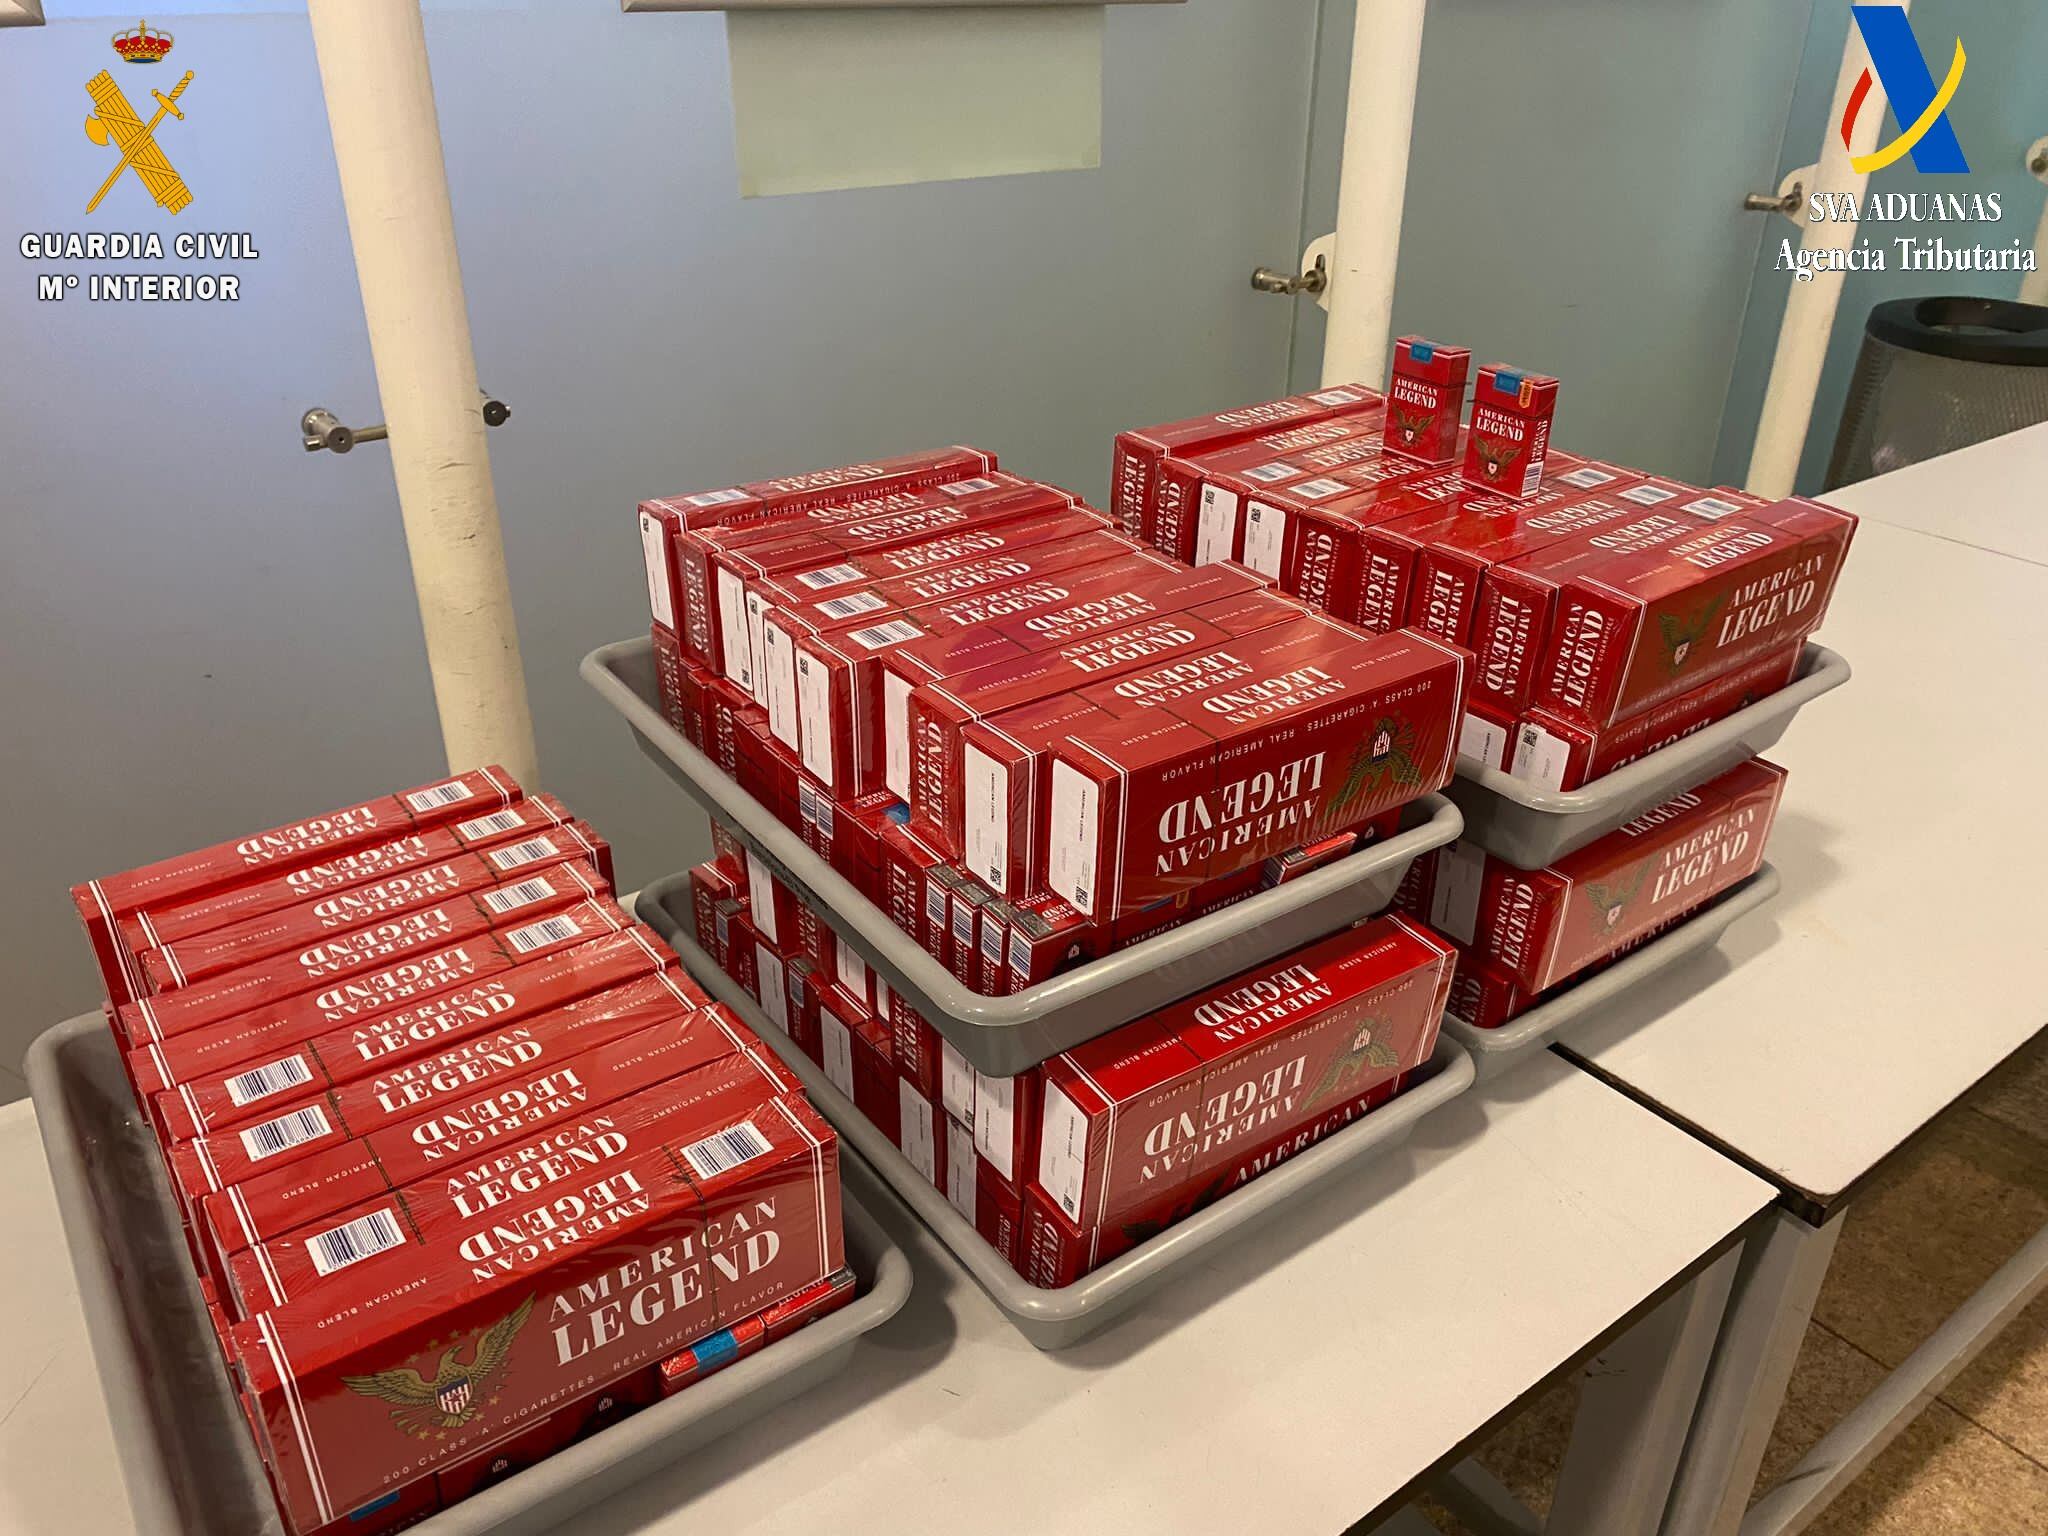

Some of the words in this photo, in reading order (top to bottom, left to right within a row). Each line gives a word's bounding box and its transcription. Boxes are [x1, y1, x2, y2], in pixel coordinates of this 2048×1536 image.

[1394, 387, 1437, 409] LEGEND
[1395, 378, 1438, 396] AMERICAN
[1265, 426, 1350, 451] LEGEND
[1476, 417, 1523, 441] LEGEND
[1478, 408, 1525, 428] AMERICAN
[775, 467, 884, 492] LEGEND
[1313, 442, 1383, 467] LEGEN
[848, 506, 962, 537] LEGEND
[862, 513, 969, 541] AMERICAN
[1155, 476, 1168, 548] MERICAN
[1163, 482, 1181, 558] EGEND
[1526, 499, 1614, 530] LEGEND
[1589, 515, 1677, 549] LEGEND
[881, 530, 991, 560] AMERICAN
[890, 535, 1005, 570] LEGEND
[1668, 525, 1749, 558] AMERICAN
[1683, 532, 1773, 568] LEGEND
[904, 555, 1015, 587] AMERICAN
[911, 561, 1031, 598] LEGEND
[1310, 534, 1332, 609] EGEND
[1363, 555, 1388, 634] LEGEN
[1729, 554, 1824, 610] AMERICAN
[939, 580, 1053, 615] AMERICAN
[950, 587, 1069, 626] LEGEND
[1025, 591, 1147, 631] LEGEND
[1042, 603, 1157, 640] AMERICAN
[1381, 561, 1399, 636] AMERIC
[1427, 570, 1453, 639] LEGE
[1446, 577, 1465, 640] AMERI
[1716, 580, 1815, 648] LEGEND
[1059, 621, 1177, 659] AMERICAN
[1070, 629, 1196, 673] LEGEND
[1486, 595, 1519, 691] LEGEND
[1504, 602, 1532, 698] AMERICAN
[1551, 602, 1583, 698] AMERICAN
[1564, 610, 1603, 707] LEGEND
[1114, 651, 1241, 698] LEGEND
[1135, 663, 1254, 709] AMERICAN
[1202, 665, 1333, 714] LEGEND
[1386, 688, 1413, 705] CLASS
[1225, 678, 1346, 725] AMERICAN
[1307, 704, 1365, 732] CIGARETTES
[1210, 739, 1264, 767] AMERICAN
[1269, 729, 1295, 744] REAL
[927, 721, 943, 827] LEGEND
[1159, 752, 1327, 844] LEGEND
[1162, 762, 1206, 782] FLAVOR
[236, 806, 376, 857] LEGEND
[1155, 795, 1320, 876] AMERICAN
[1619, 793, 1702, 837] LEGEND
[1659, 808, 1754, 868] AMERICAN
[244, 818, 378, 866] AMERICAN
[286, 835, 425, 886] LEGEND
[1651, 831, 1749, 905] LEGEND
[294, 847, 428, 896] AMERICAN
[313, 865, 458, 918] LEGEND
[322, 877, 461, 929] AMERICAN
[1491, 877, 1514, 954] AMERICAN
[1501, 884, 1534, 969] LEGEND
[299, 908, 450, 968] LEGEND
[307, 922, 453, 978] AMERICAN
[316, 947, 471, 1010] LEGEND
[325, 962, 476, 1023] AMERICAN
[1193, 964, 1321, 1027] LEGEND
[352, 981, 504, 1044] AMERICAN
[355, 991, 516, 1061] LEGEND
[1215, 984, 1333, 1042] AMERICAN
[1290, 1012, 1348, 1043] CIGARETTES
[372, 1026, 531, 1093] AMERICAN
[1254, 1041, 1279, 1058] REAL
[376, 1040, 543, 1114] LEGEND
[411, 1068, 582, 1145] LEGEND
[423, 1086, 588, 1162] AMERICAN
[652, 1095, 702, 1120] AMERICAN
[1144, 1055, 1307, 1157] LEGEND
[446, 1115, 615, 1195] AMERICAN
[1139, 1093, 1303, 1185] AMERICAN
[1234, 1096, 1371, 1186] AMERICAN
[282, 1182, 320, 1200] BLEND
[451, 1131, 628, 1220] LEGEND
[459, 1170, 645, 1263] LEGEND
[471, 1194, 650, 1284] AMERICAN
[549, 1197, 777, 1323] AMERICAN
[365, 1276, 428, 1309] AMERICAN
[552, 1229, 781, 1367] LEGEND
[316, 1308, 360, 1330] BLEND
[383, 1466, 410, 1484] 200
[418, 1438, 468, 1467] CLASS
[503, 1374, 595, 1426] CIGARETTES
[613, 1349, 648, 1370] REAL
[656, 1310, 727, 1350] AMERICAN
[734, 1280, 785, 1313] FLAVOR
